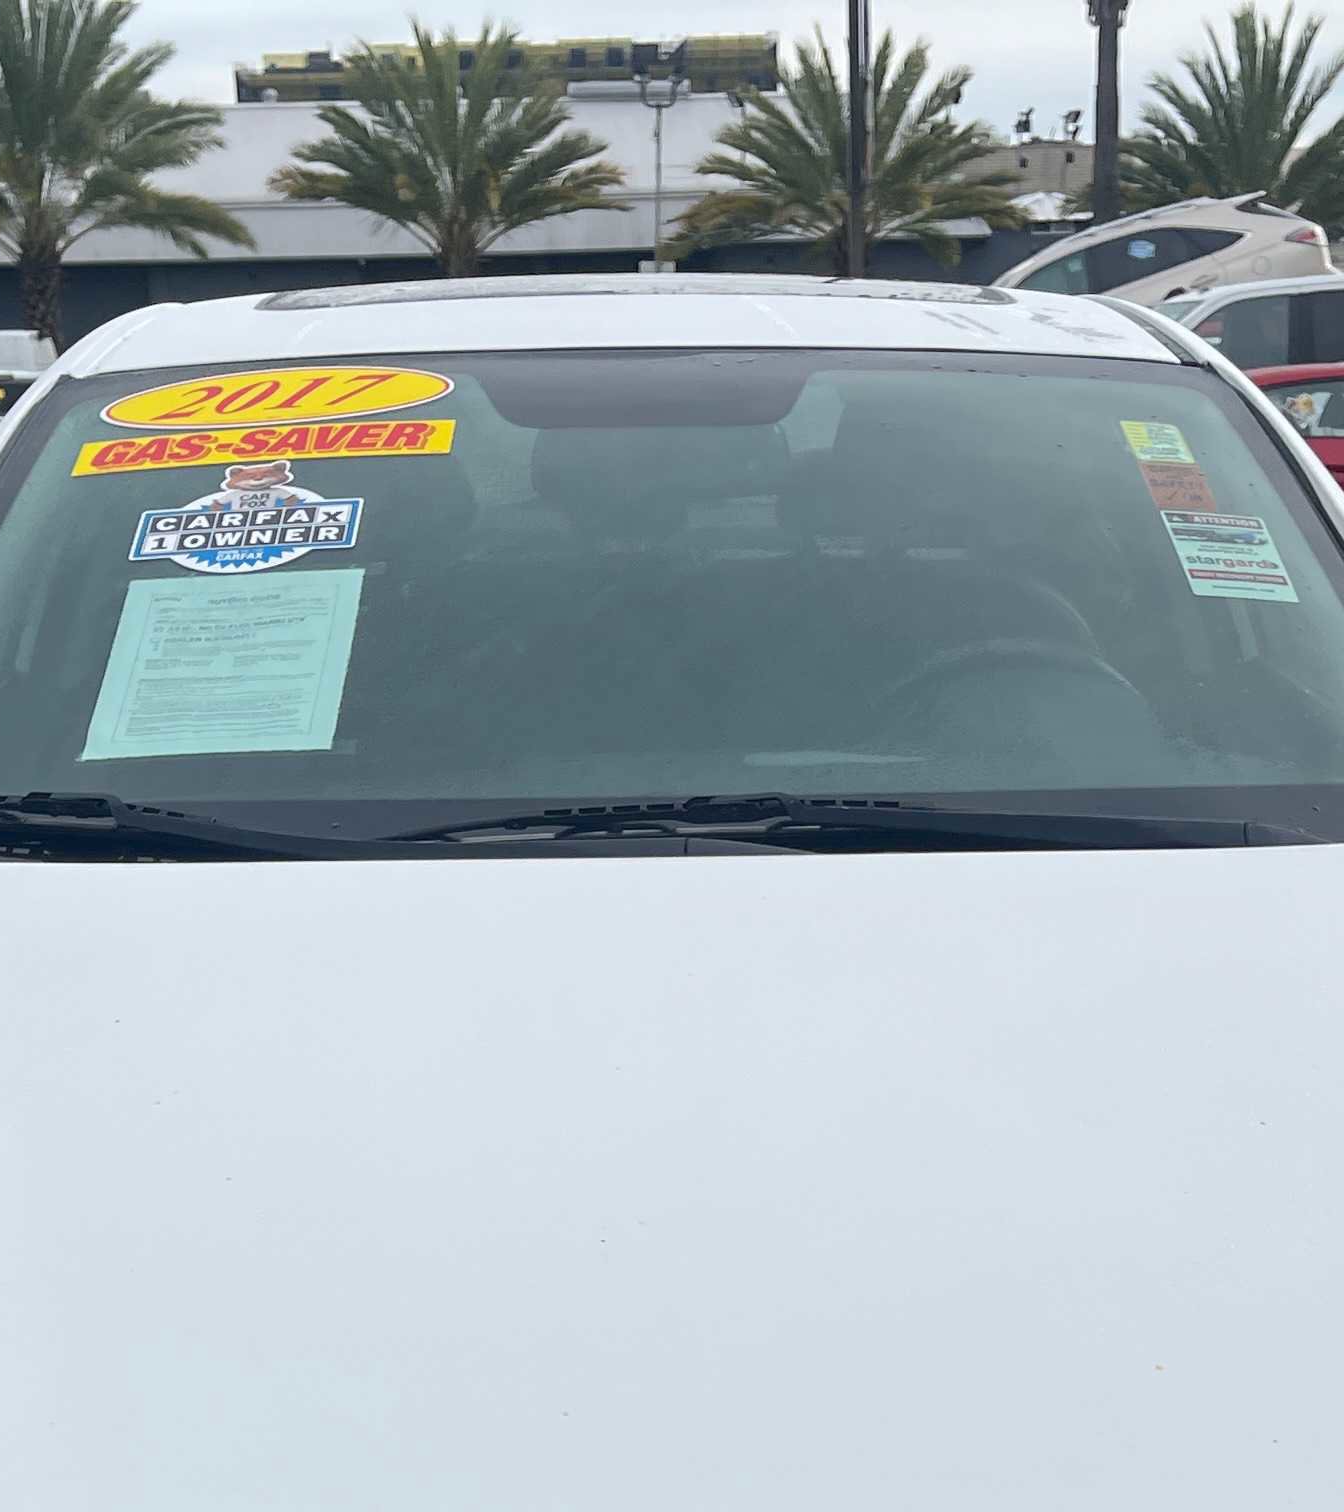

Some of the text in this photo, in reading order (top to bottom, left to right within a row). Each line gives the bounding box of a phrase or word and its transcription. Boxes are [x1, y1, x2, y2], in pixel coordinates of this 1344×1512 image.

[151, 373, 400, 421] 2017
[90, 422, 437, 470] GAS-SAVER
[239, 493, 270, 502] CAR
[239, 500, 268, 509] FOX
[155, 508, 345, 532] CARFAX
[182, 526, 340, 548] OWNER
